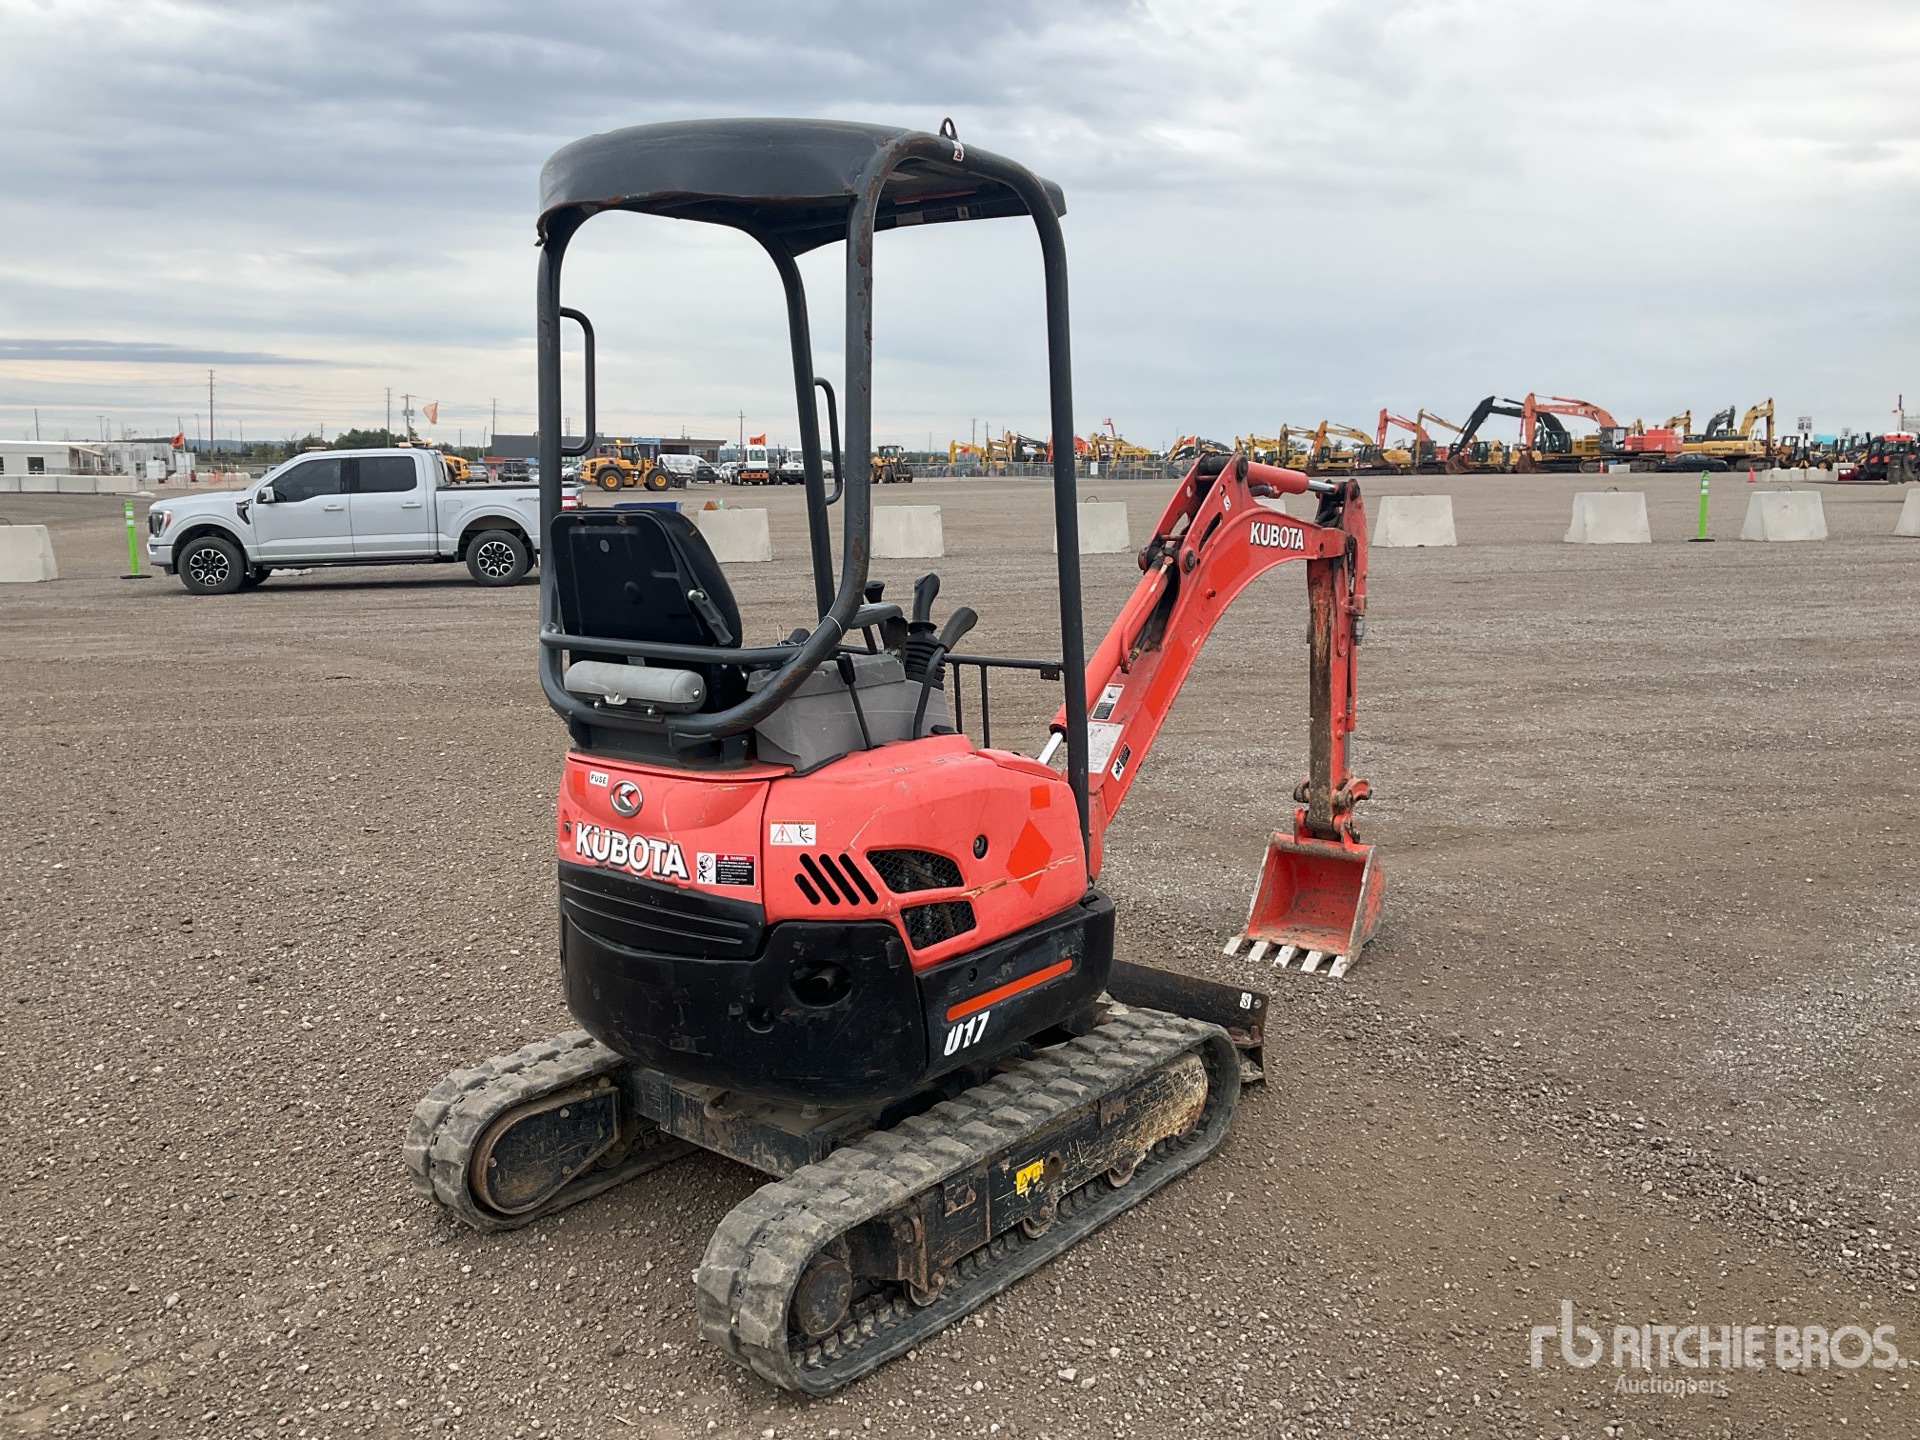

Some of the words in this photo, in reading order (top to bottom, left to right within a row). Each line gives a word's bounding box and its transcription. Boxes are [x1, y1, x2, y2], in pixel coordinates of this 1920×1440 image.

[1249, 521, 1305, 551] KUBOTA
[590, 773, 607, 785] FUSE
[575, 821, 690, 880] KUBOTA
[943, 1010, 991, 1057] U17
